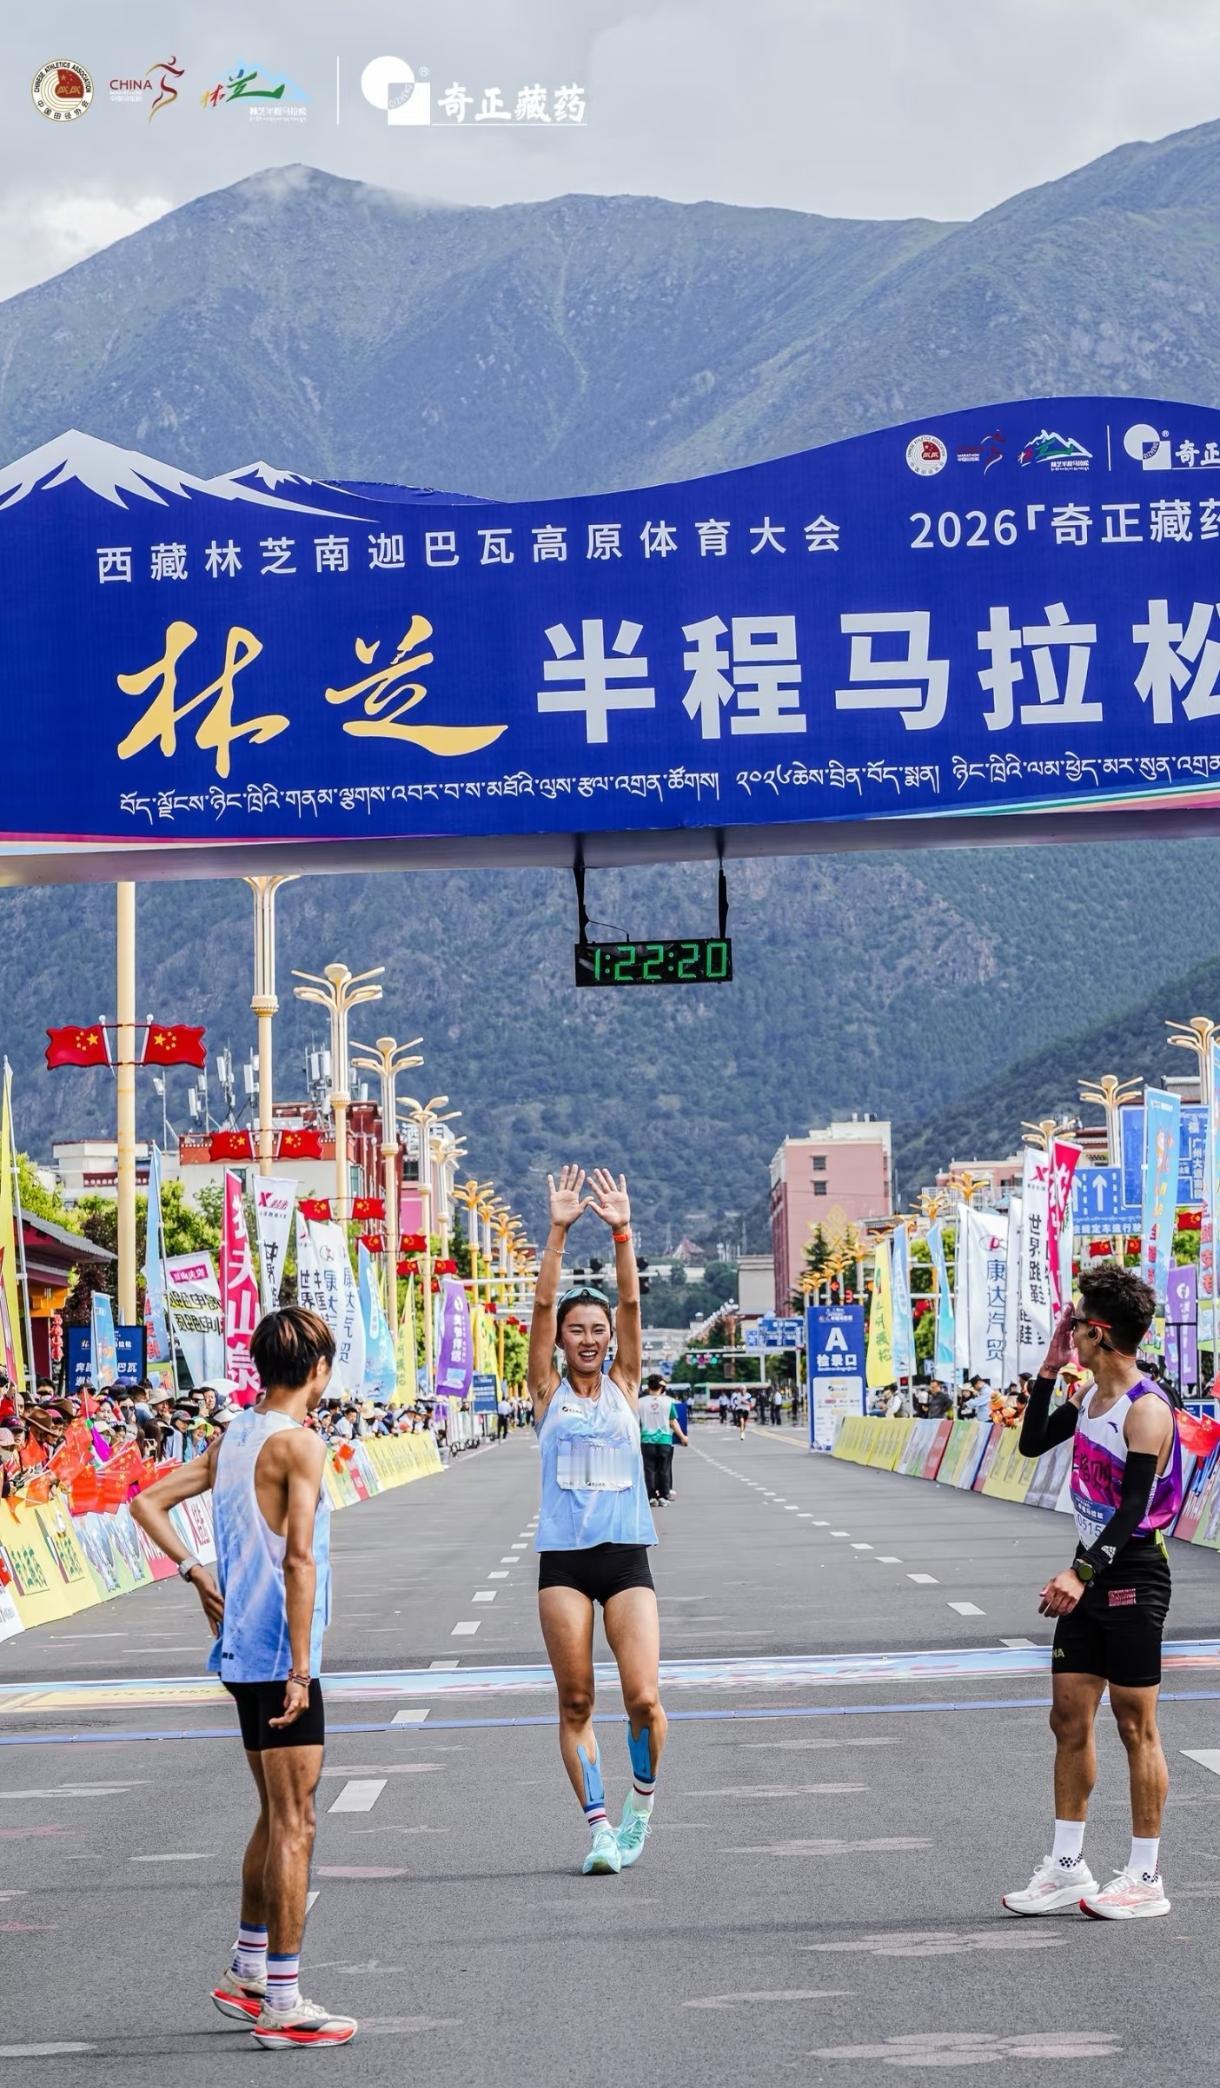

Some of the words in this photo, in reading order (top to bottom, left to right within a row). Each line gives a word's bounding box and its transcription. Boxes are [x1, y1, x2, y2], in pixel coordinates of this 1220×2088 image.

[96, 514, 842, 584] 西藏林芝南迦巴瓦高原体育大会
[537, 599, 1220, 745] 半程马拉松
[593, 942, 728, 982] 1:22:20
[984, 1258, 1007, 1362] 康达汽贸
[816, 1353, 857, 1367] 检录口
[825, 1326, 849, 1352] A
